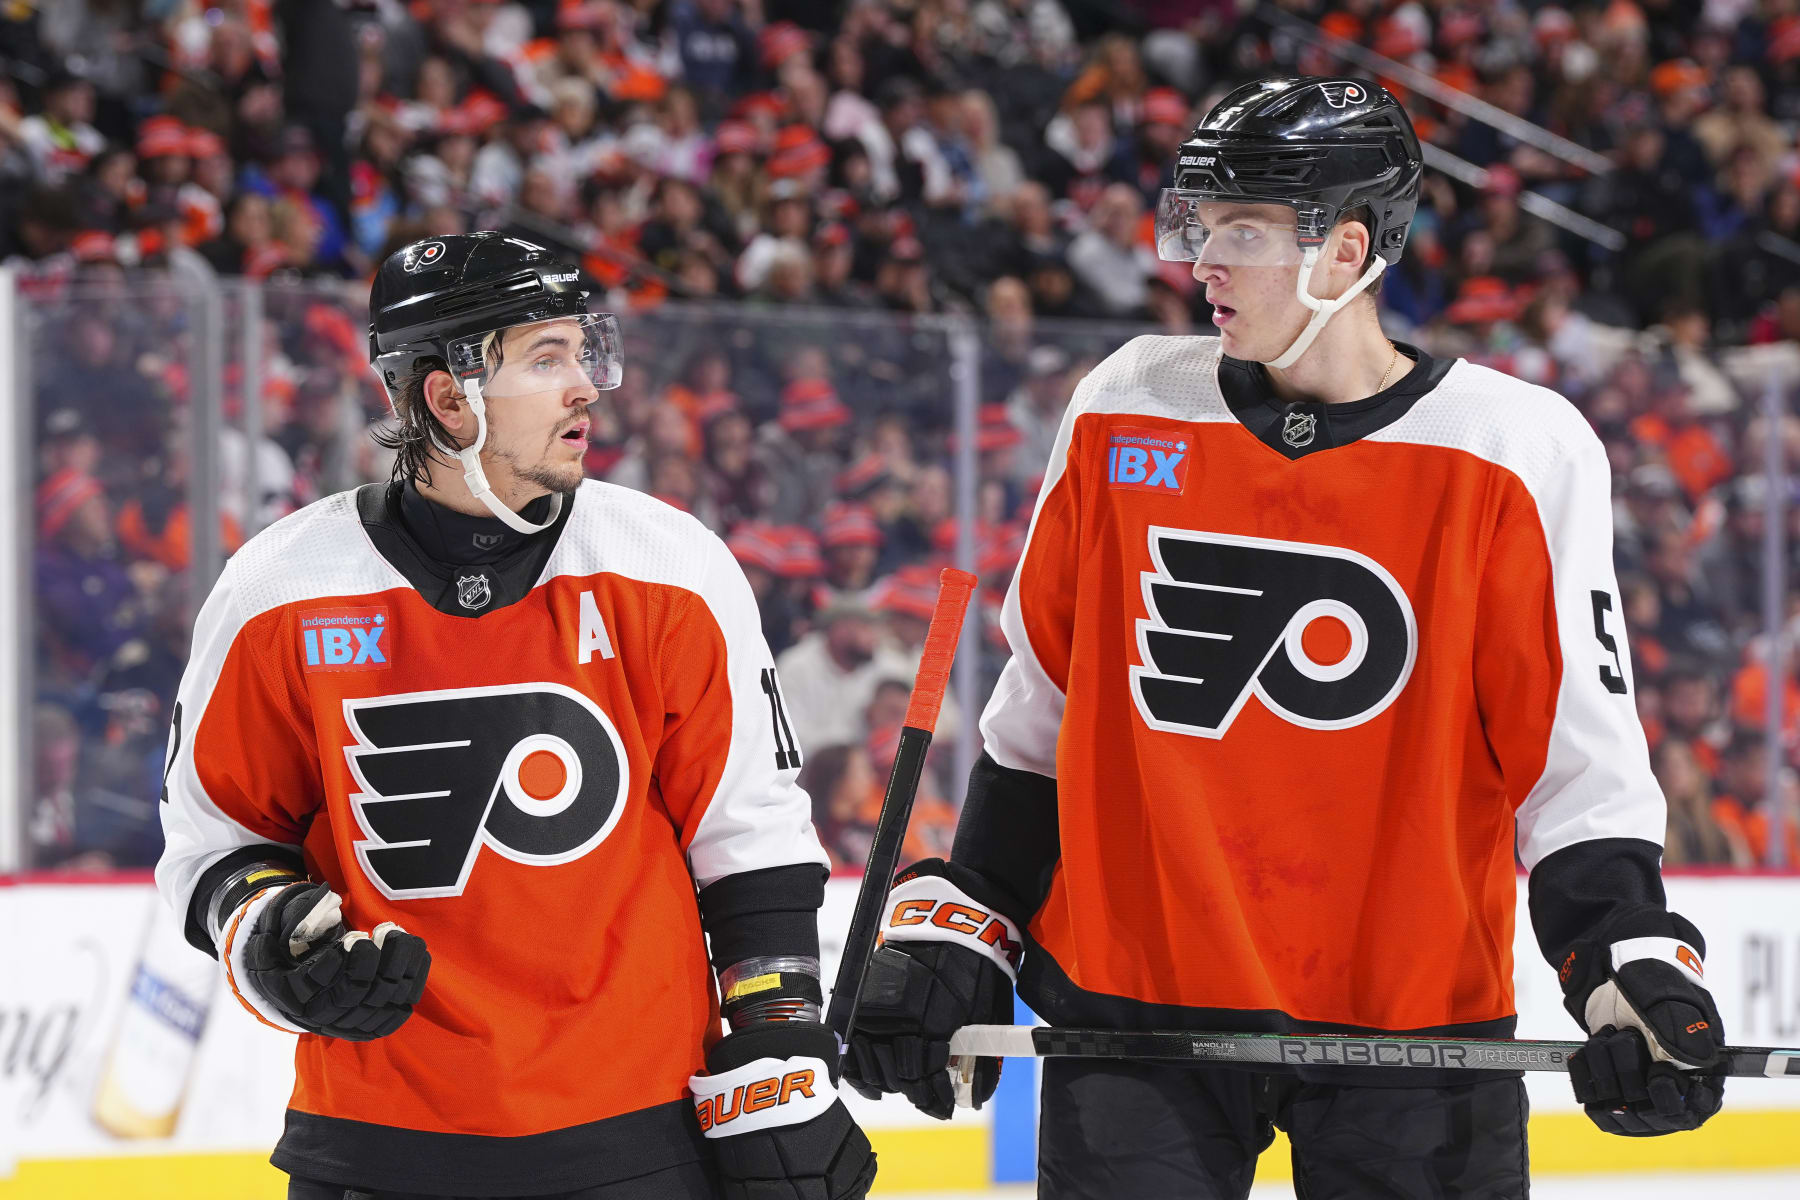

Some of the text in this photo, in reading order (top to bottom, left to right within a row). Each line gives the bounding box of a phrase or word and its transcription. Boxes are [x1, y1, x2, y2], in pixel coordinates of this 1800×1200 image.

[1180, 156, 1216, 167] BAUER
[541, 272, 579, 283] BAUER
[1110, 434, 1174, 449] Independence
[1108, 446, 1185, 489] IBX
[302, 614, 371, 627] Independence
[578, 590, 616, 665] A
[303, 626, 387, 666] IBX
[1590, 589, 1628, 695] 5
[760, 668, 802, 771] 11
[889, 899, 1022, 970] CCM
[1192, 1041, 1237, 1049] NANOLITE
[1278, 1039, 1468, 1068] RIBCOR
[1473, 1049, 1549, 1064] TRIGGER
[696, 1068, 817, 1133] AUER
